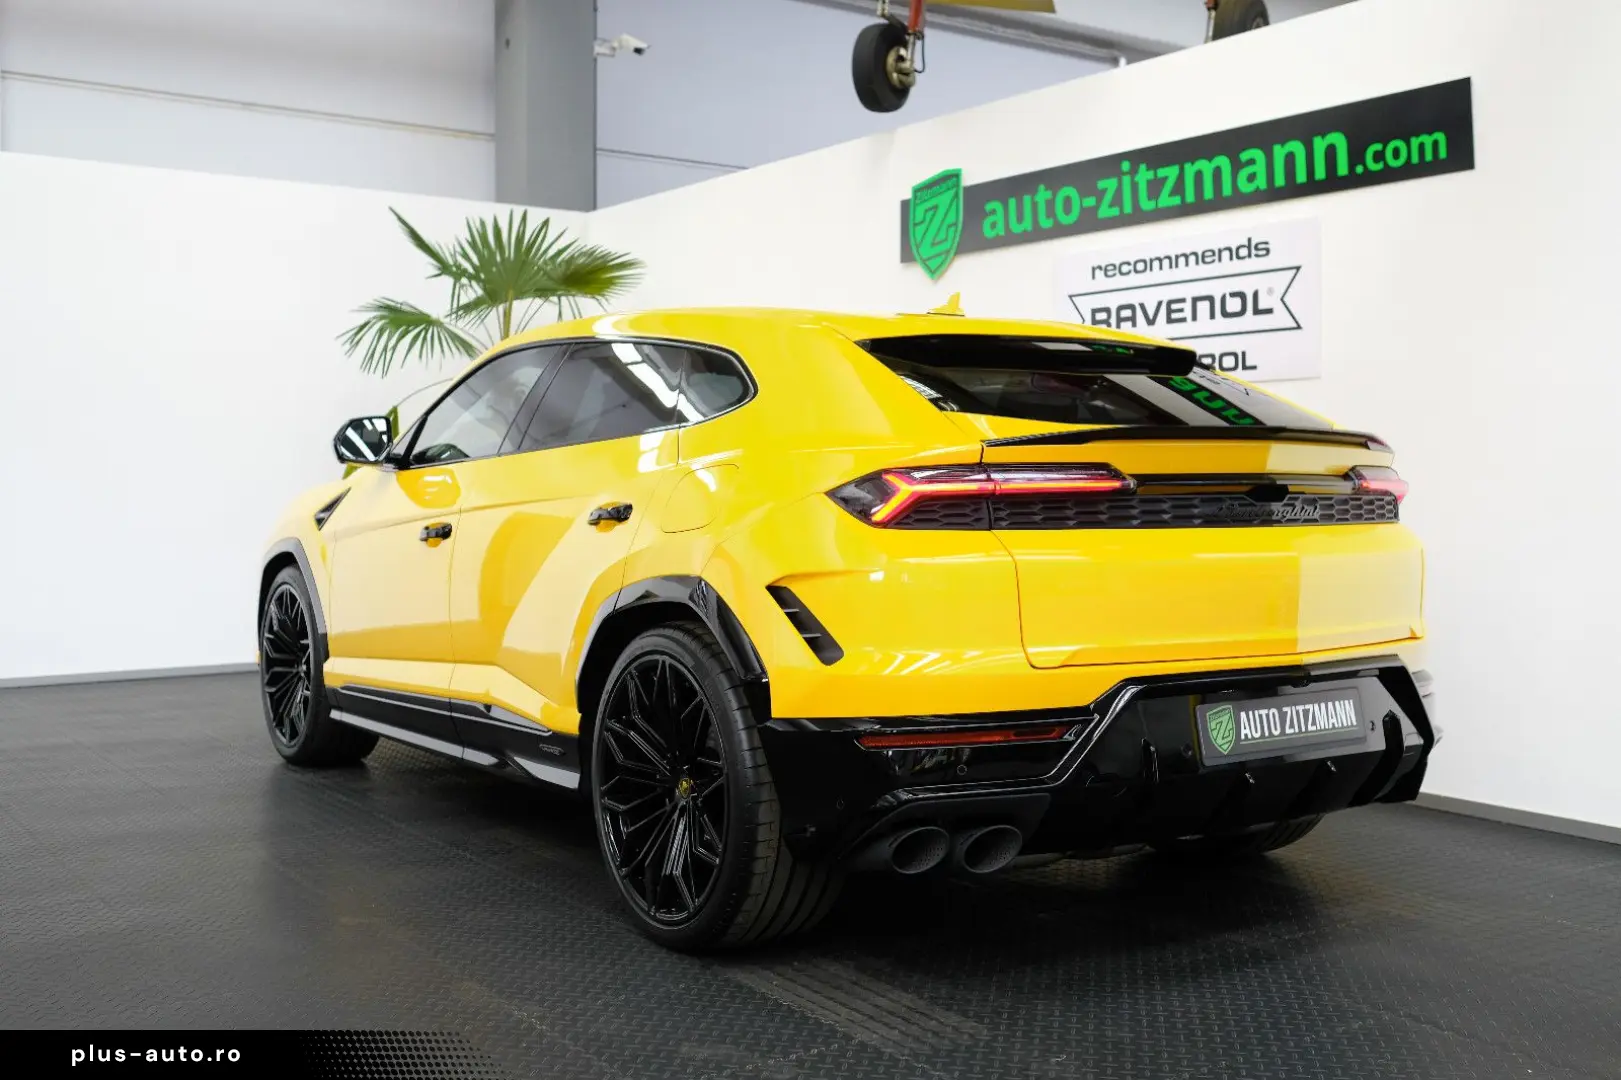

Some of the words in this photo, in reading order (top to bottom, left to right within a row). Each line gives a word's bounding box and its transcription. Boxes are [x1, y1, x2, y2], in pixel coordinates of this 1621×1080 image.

[982, 131, 1447, 239] auto-zitzmann.com
[1092, 238, 1271, 280] recommends
[1091, 289, 1274, 328] RAVENOL
[1197, 351, 1257, 371] ROL
[1240, 708, 1281, 740] AUTO
[1283, 699, 1357, 734] ZITZMANN
